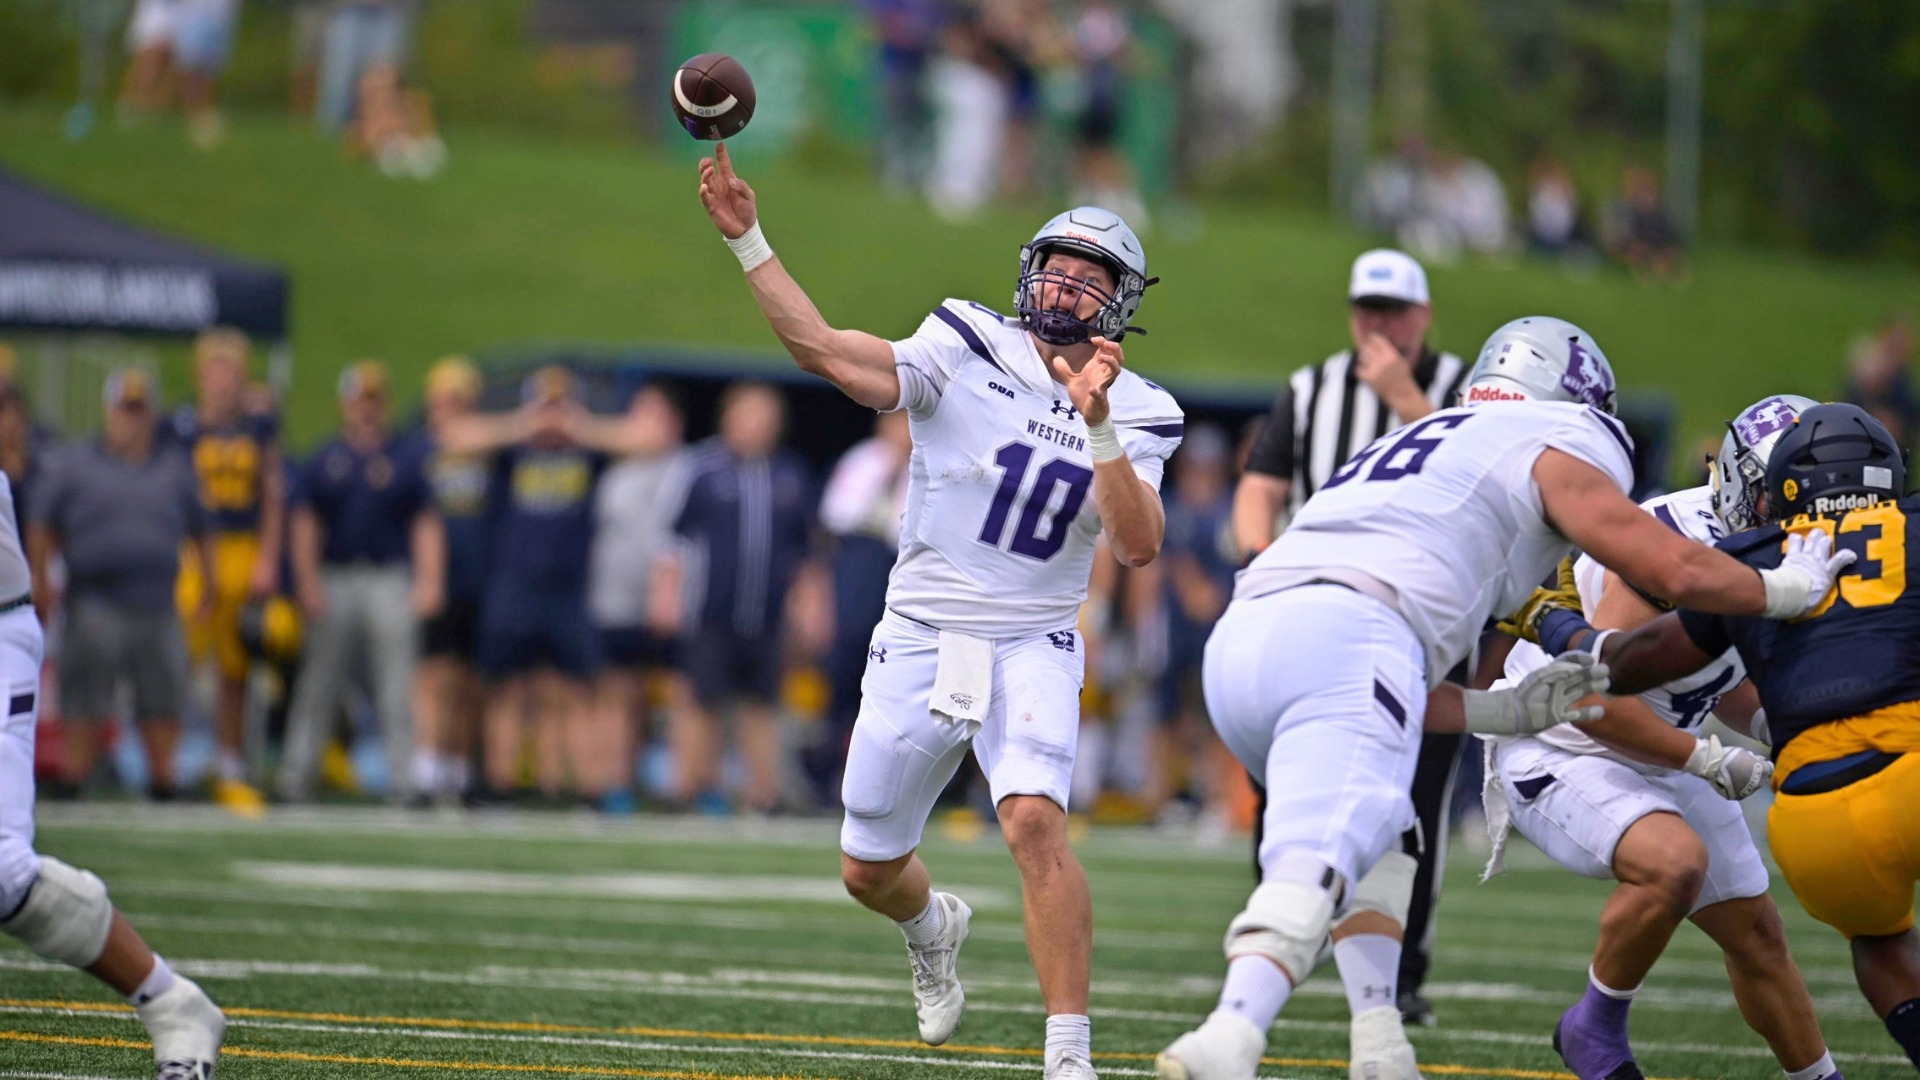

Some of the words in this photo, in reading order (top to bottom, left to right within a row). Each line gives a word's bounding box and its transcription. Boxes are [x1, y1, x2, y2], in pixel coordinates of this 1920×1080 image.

[988, 381, 1015, 399] OUA
[1027, 419, 1085, 452] WESTERN
[977, 440, 1094, 563] 10
[1815, 493, 1879, 514] Riddell
